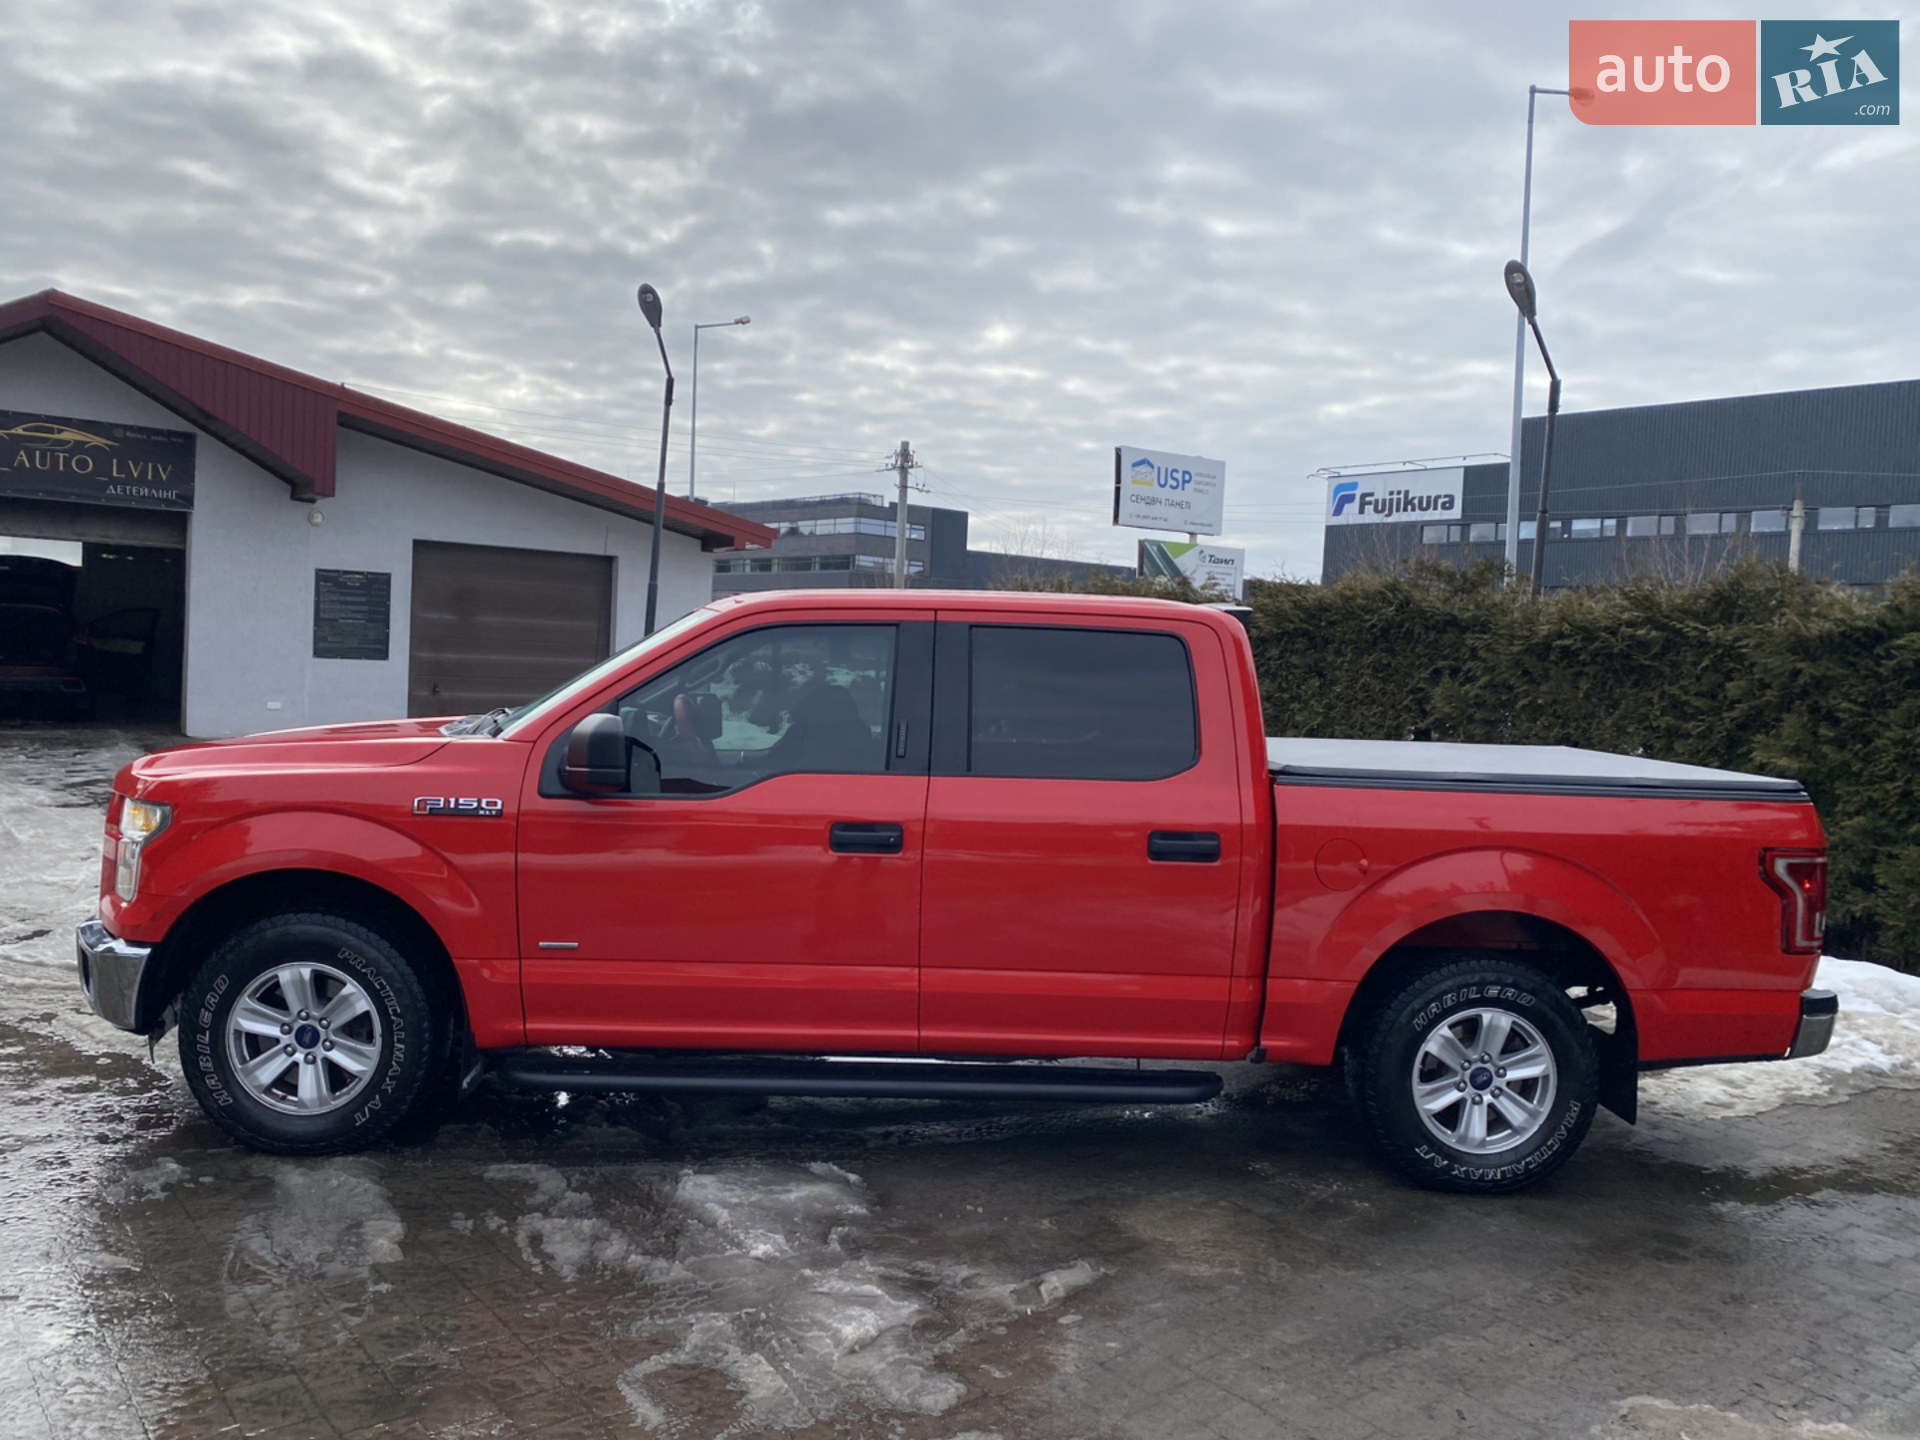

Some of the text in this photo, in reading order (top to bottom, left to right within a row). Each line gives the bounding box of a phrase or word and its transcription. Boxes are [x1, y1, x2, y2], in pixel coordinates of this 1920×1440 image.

[1156, 466, 1193, 491] USP
[1358, 489, 1456, 518] Fujikura
[1412, 985, 1536, 1033] HABILEAD
[196, 974, 234, 1108] HABILEAD
